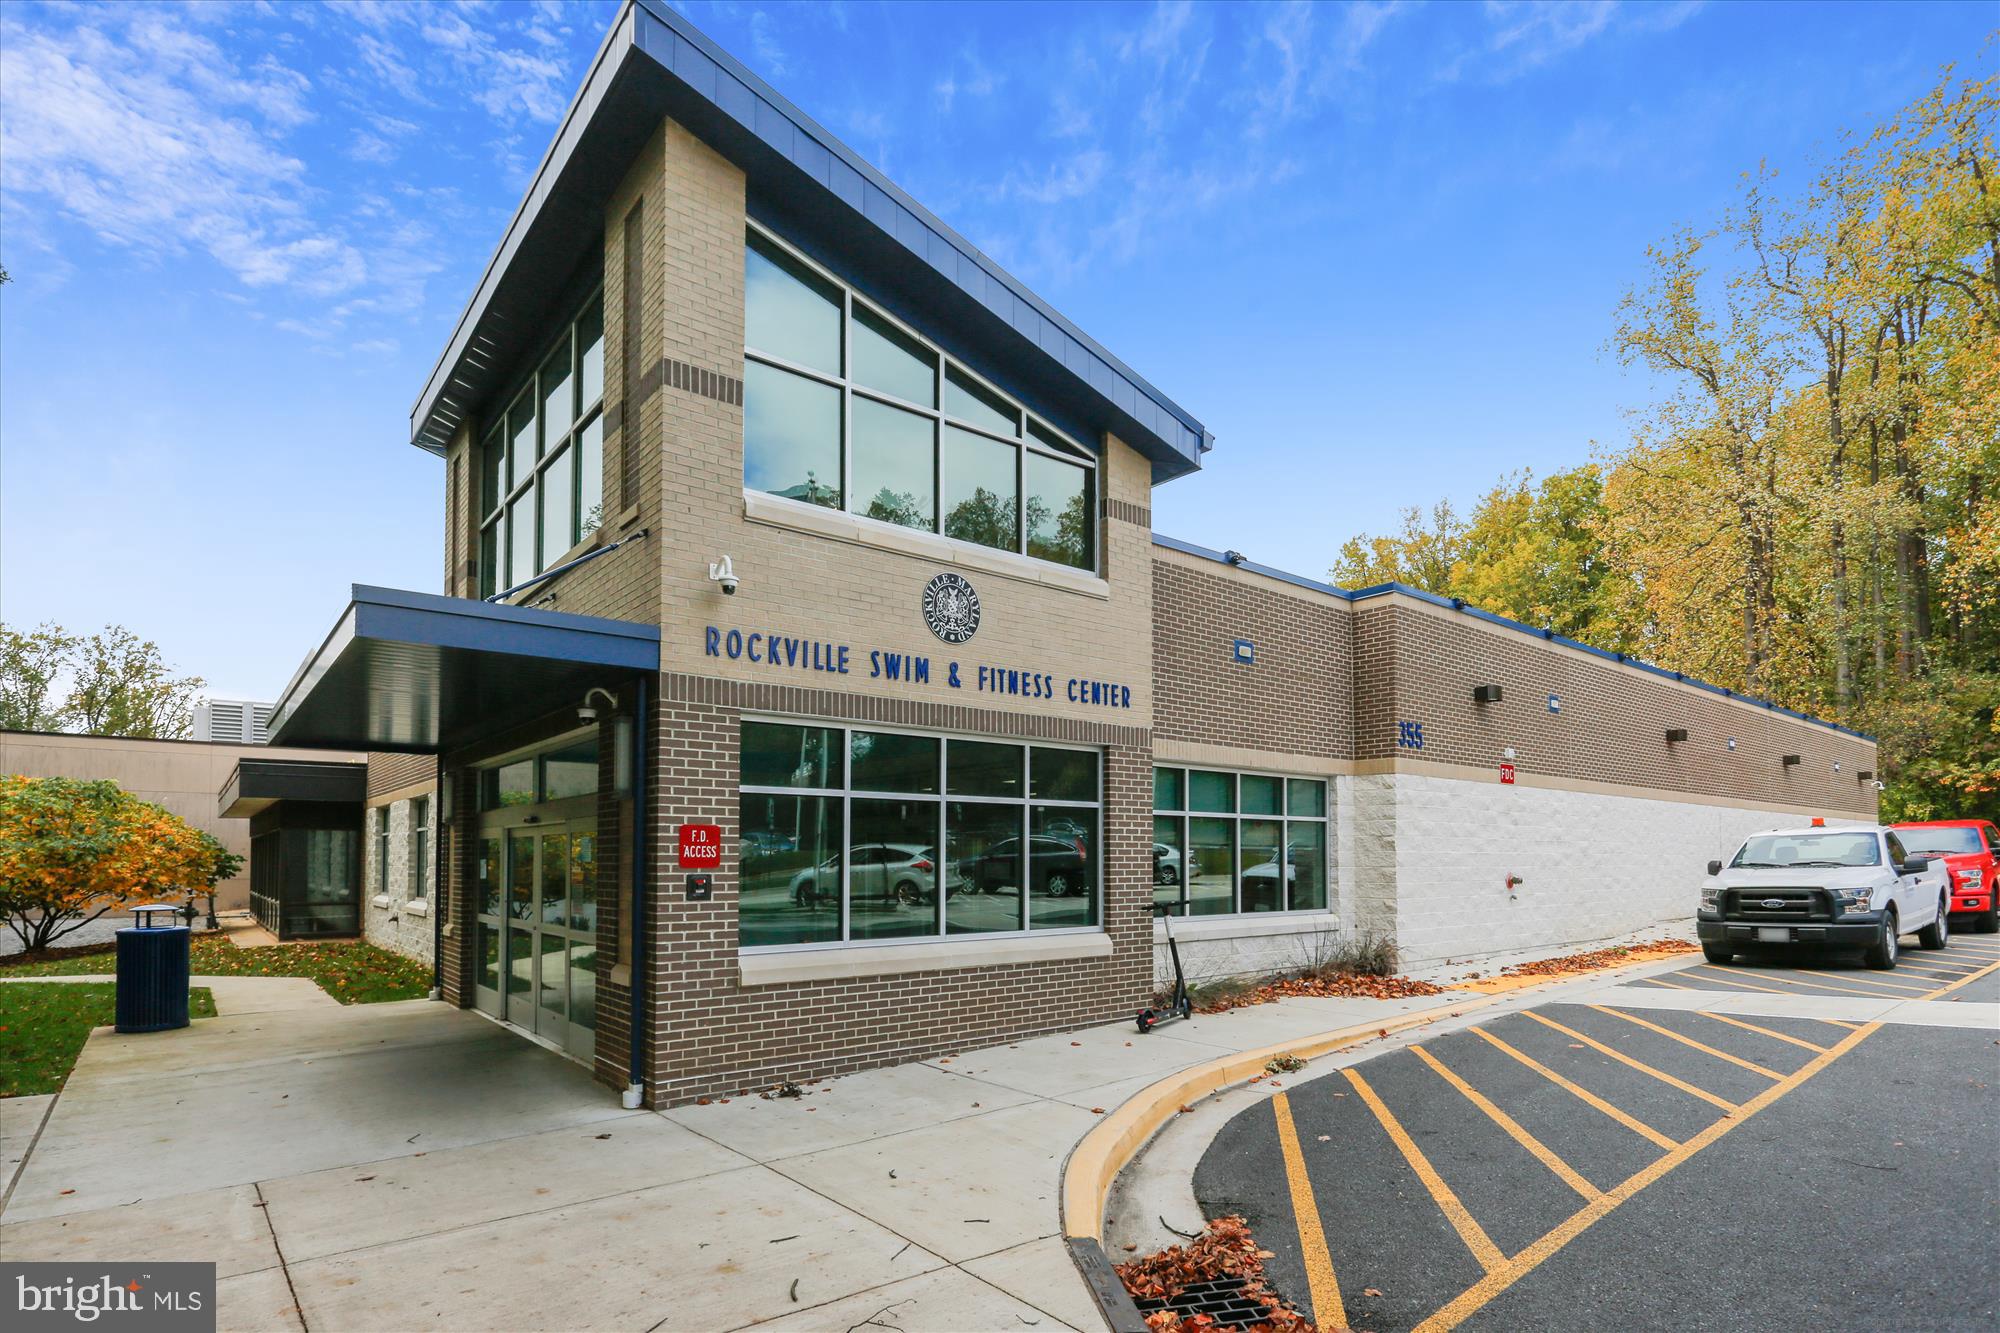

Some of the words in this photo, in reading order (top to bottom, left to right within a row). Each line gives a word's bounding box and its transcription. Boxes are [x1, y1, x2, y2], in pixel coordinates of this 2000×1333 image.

[924, 574, 950, 639] ROCKVILLE
[956, 576, 980, 642] MARYLAND
[706, 625, 850, 674] ROCKVILLE
[870, 650, 930, 684] SWIM
[948, 661, 962, 689] &
[978, 665, 1053, 699] FITNESS
[1067, 678, 1131, 709] CENTER
[1398, 721, 1424, 750] 355
[1501, 768, 1514, 780] FDC
[691, 829, 709, 843] F.D.
[683, 845, 717, 858] ACCESS
